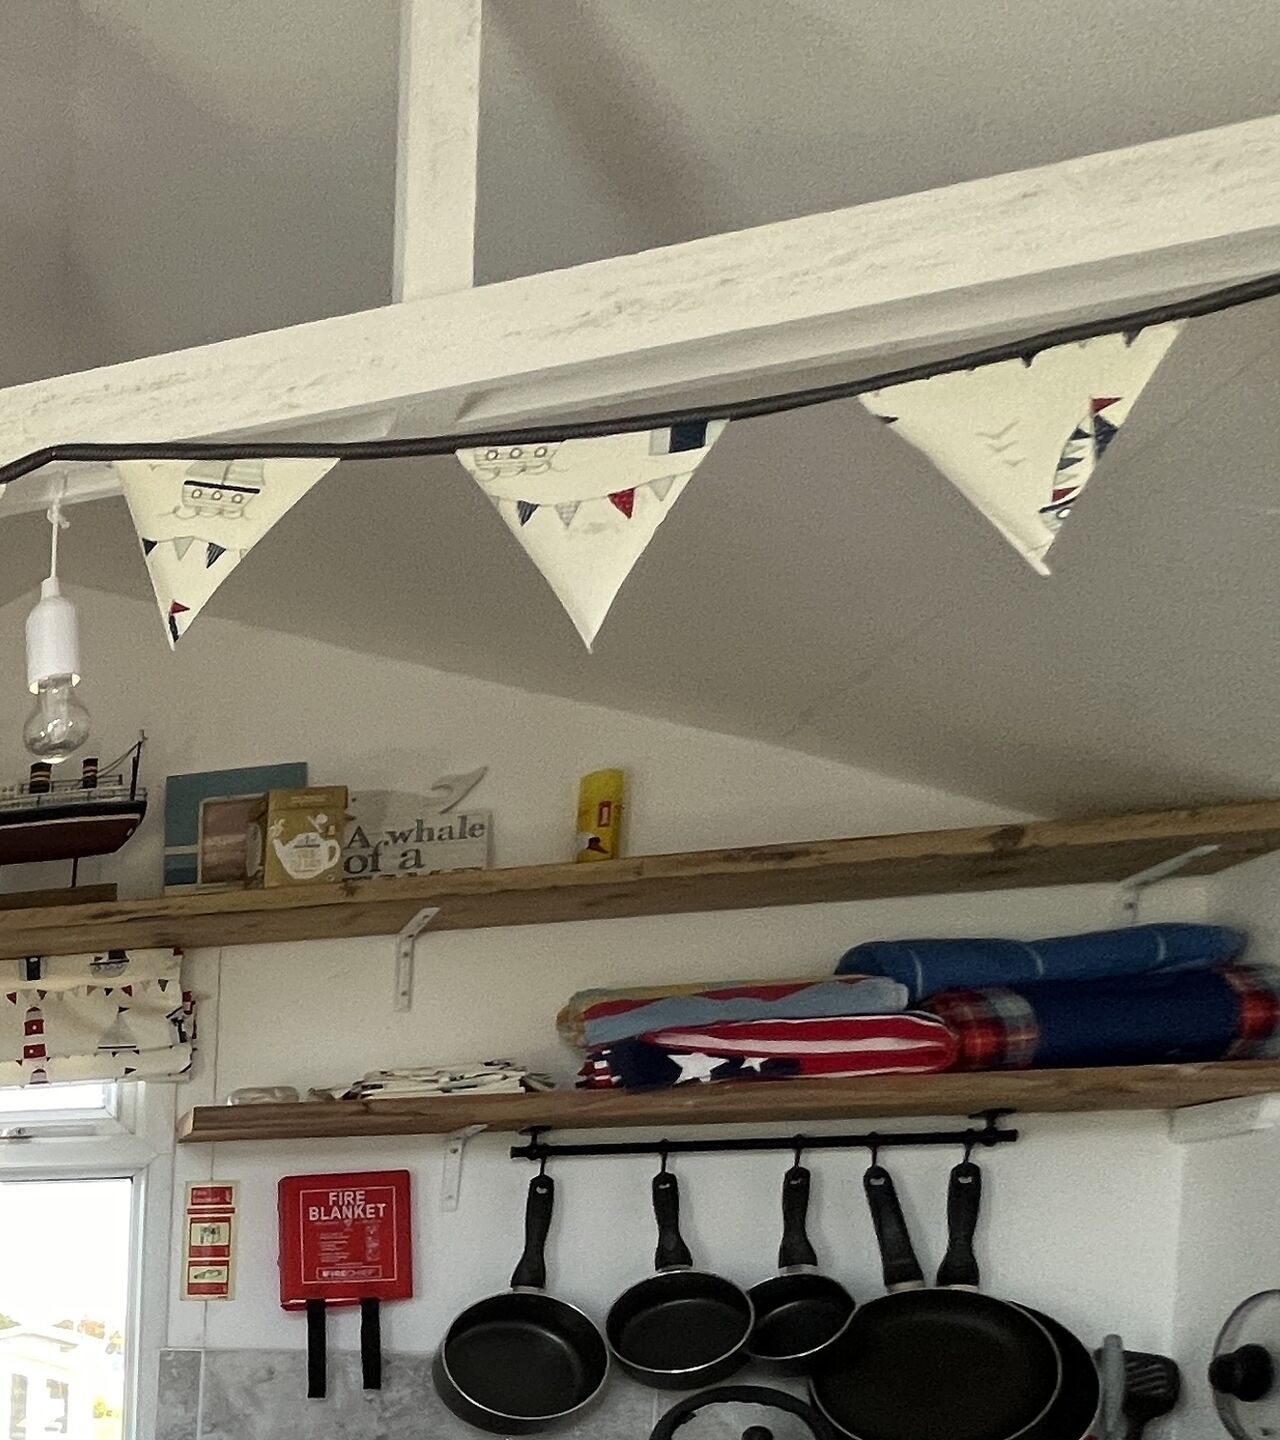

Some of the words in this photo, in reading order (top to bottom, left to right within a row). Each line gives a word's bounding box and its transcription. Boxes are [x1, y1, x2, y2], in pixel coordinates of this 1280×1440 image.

[343, 825, 371, 849] A
[385, 814, 486, 845] whale
[343, 840, 384, 875] of
[398, 848, 426, 871] a
[328, 1190, 366, 1206] FIRE
[308, 1203, 387, 1221] BLANKET
